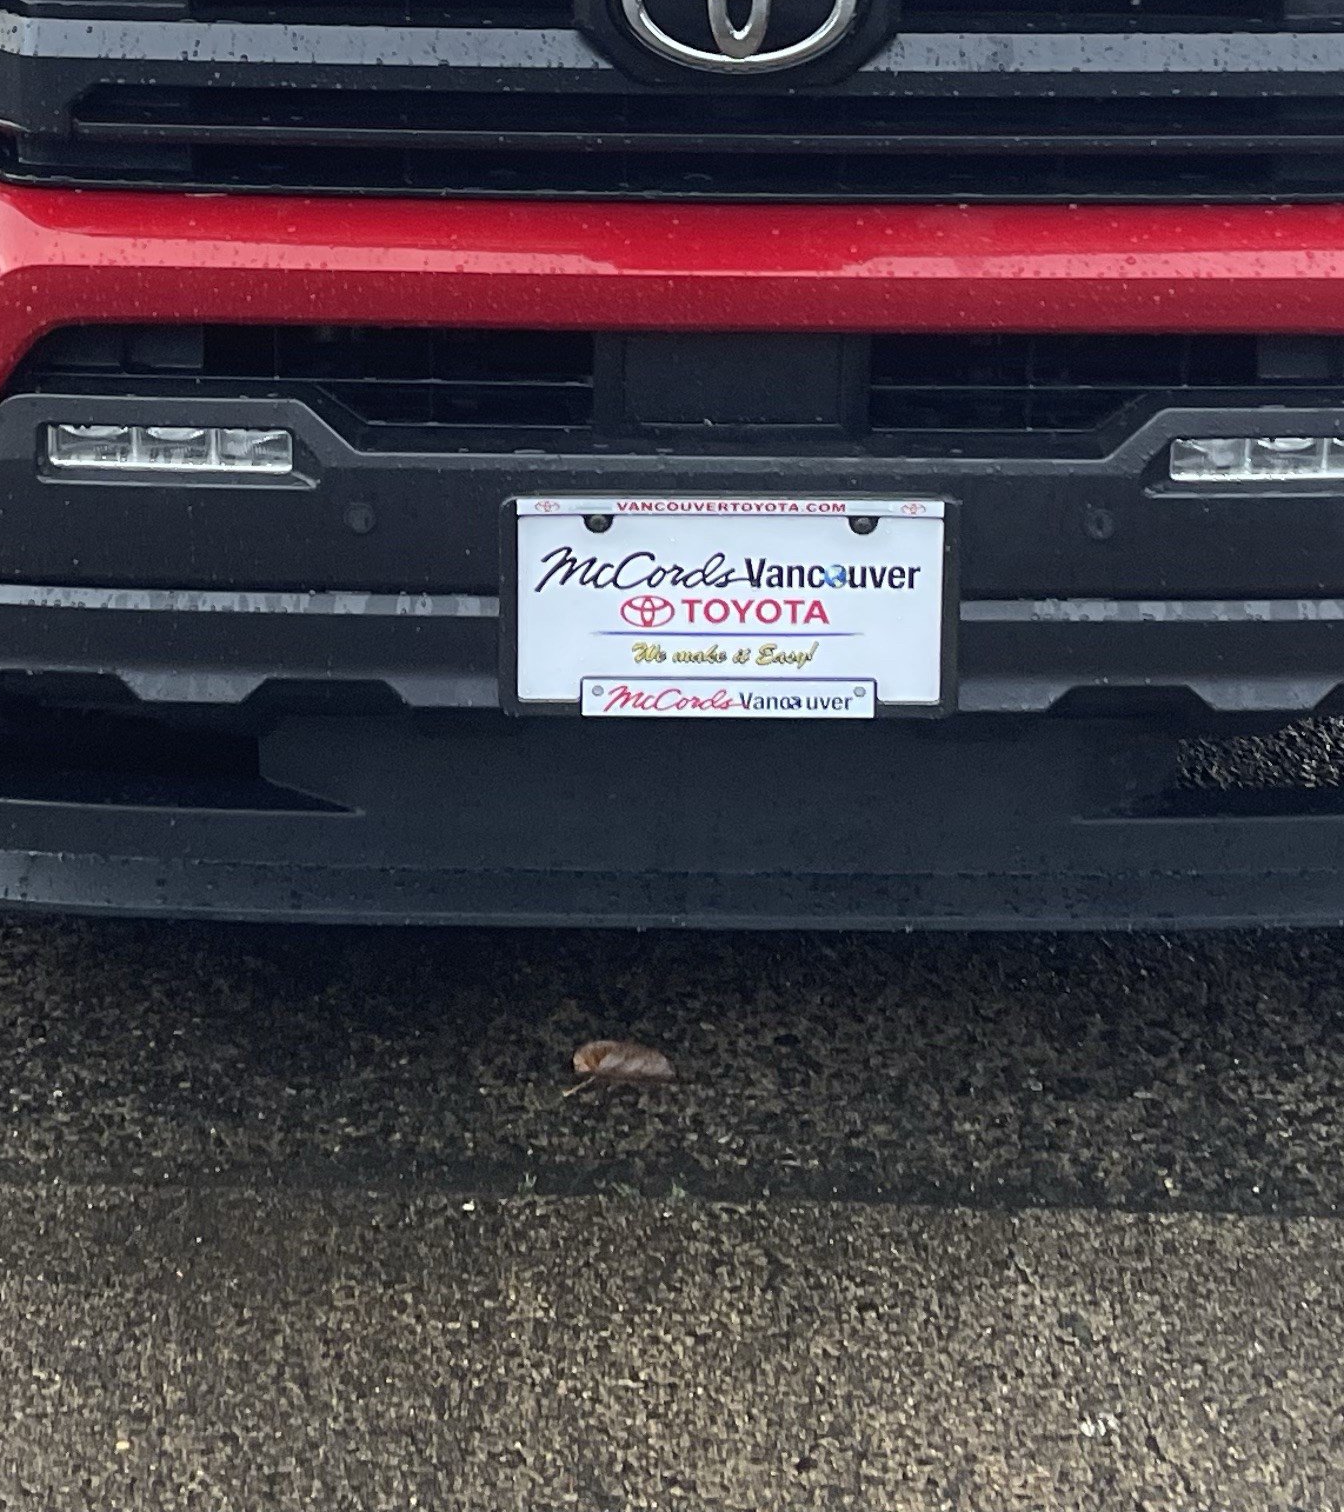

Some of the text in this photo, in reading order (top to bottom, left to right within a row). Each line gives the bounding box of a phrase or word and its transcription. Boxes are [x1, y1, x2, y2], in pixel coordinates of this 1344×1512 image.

[615, 500, 847, 514] VANCOUVERTOYOTA.COM
[681, 598, 831, 625] TOYOTA
[631, 640, 820, 669] We make it Easy!
